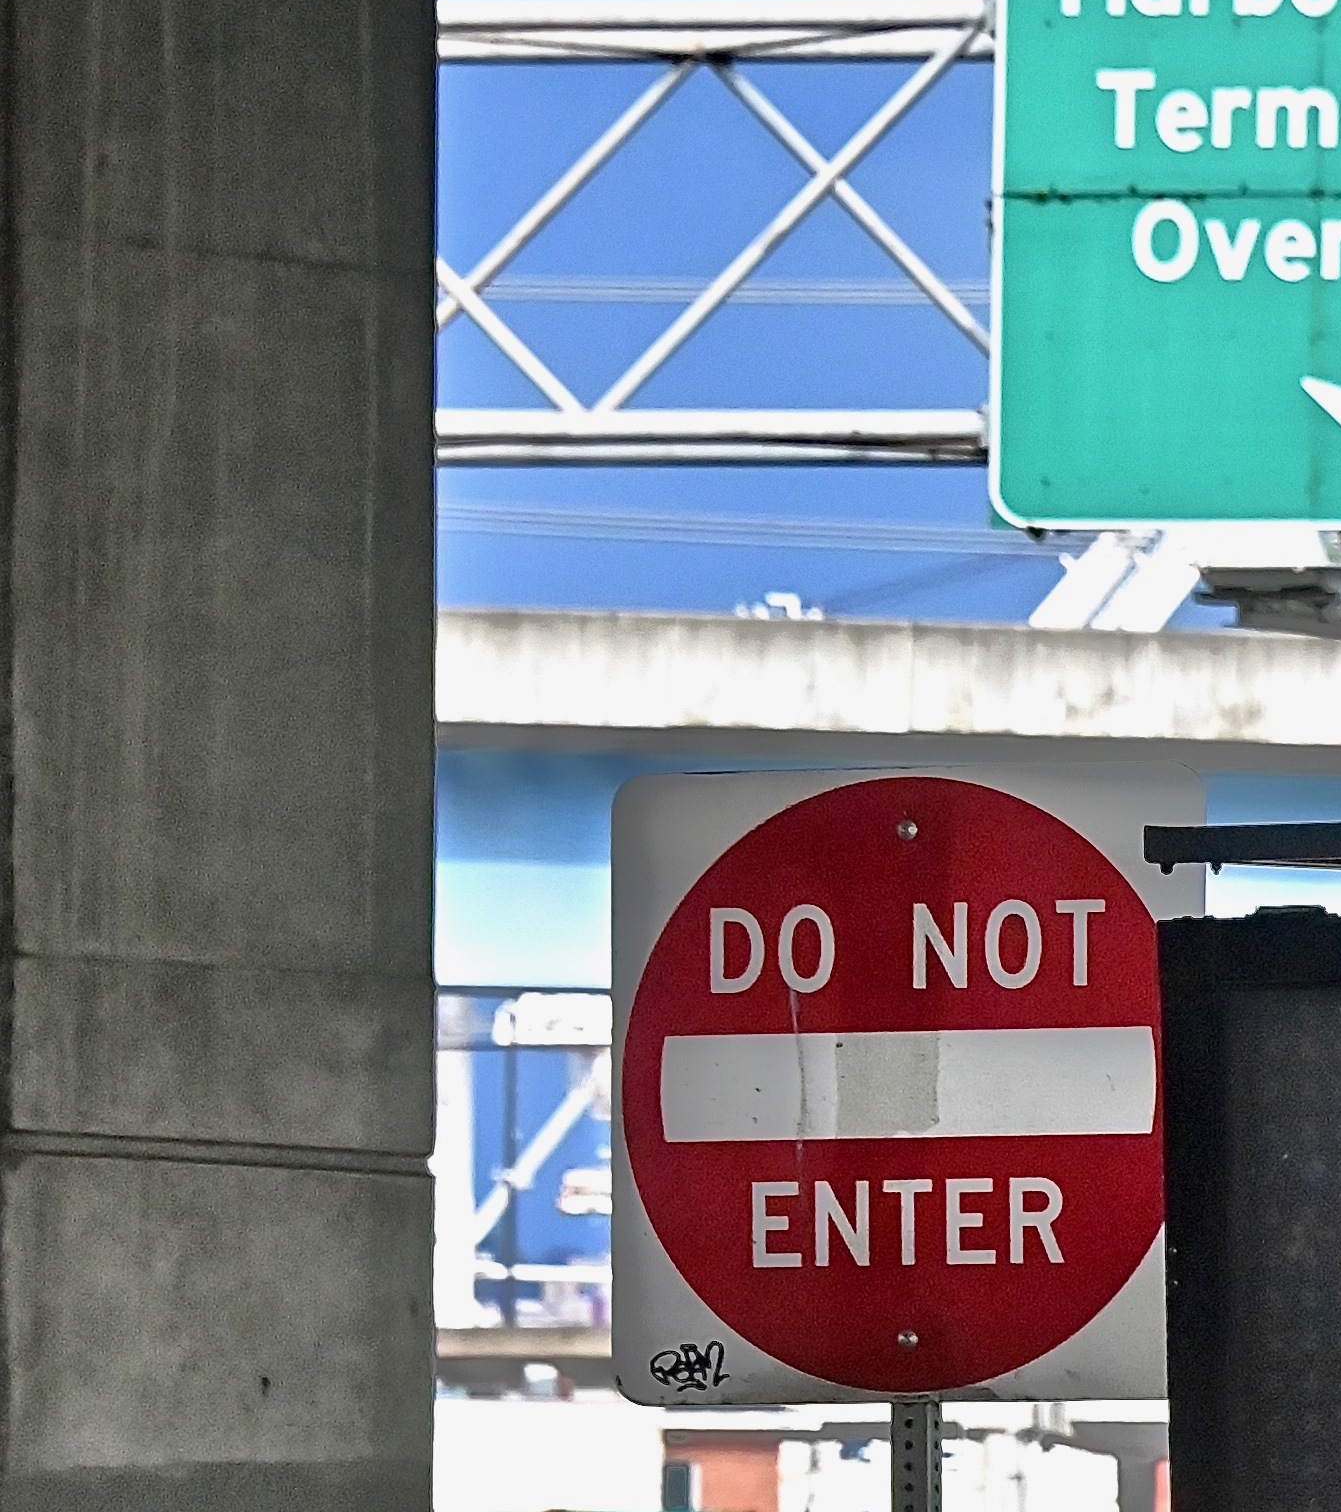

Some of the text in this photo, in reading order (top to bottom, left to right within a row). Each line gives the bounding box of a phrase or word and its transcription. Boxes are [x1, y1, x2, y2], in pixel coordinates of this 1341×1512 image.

[709, 898, 1106, 994] DO NOT
[751, 1177, 1065, 1269] ENTER
